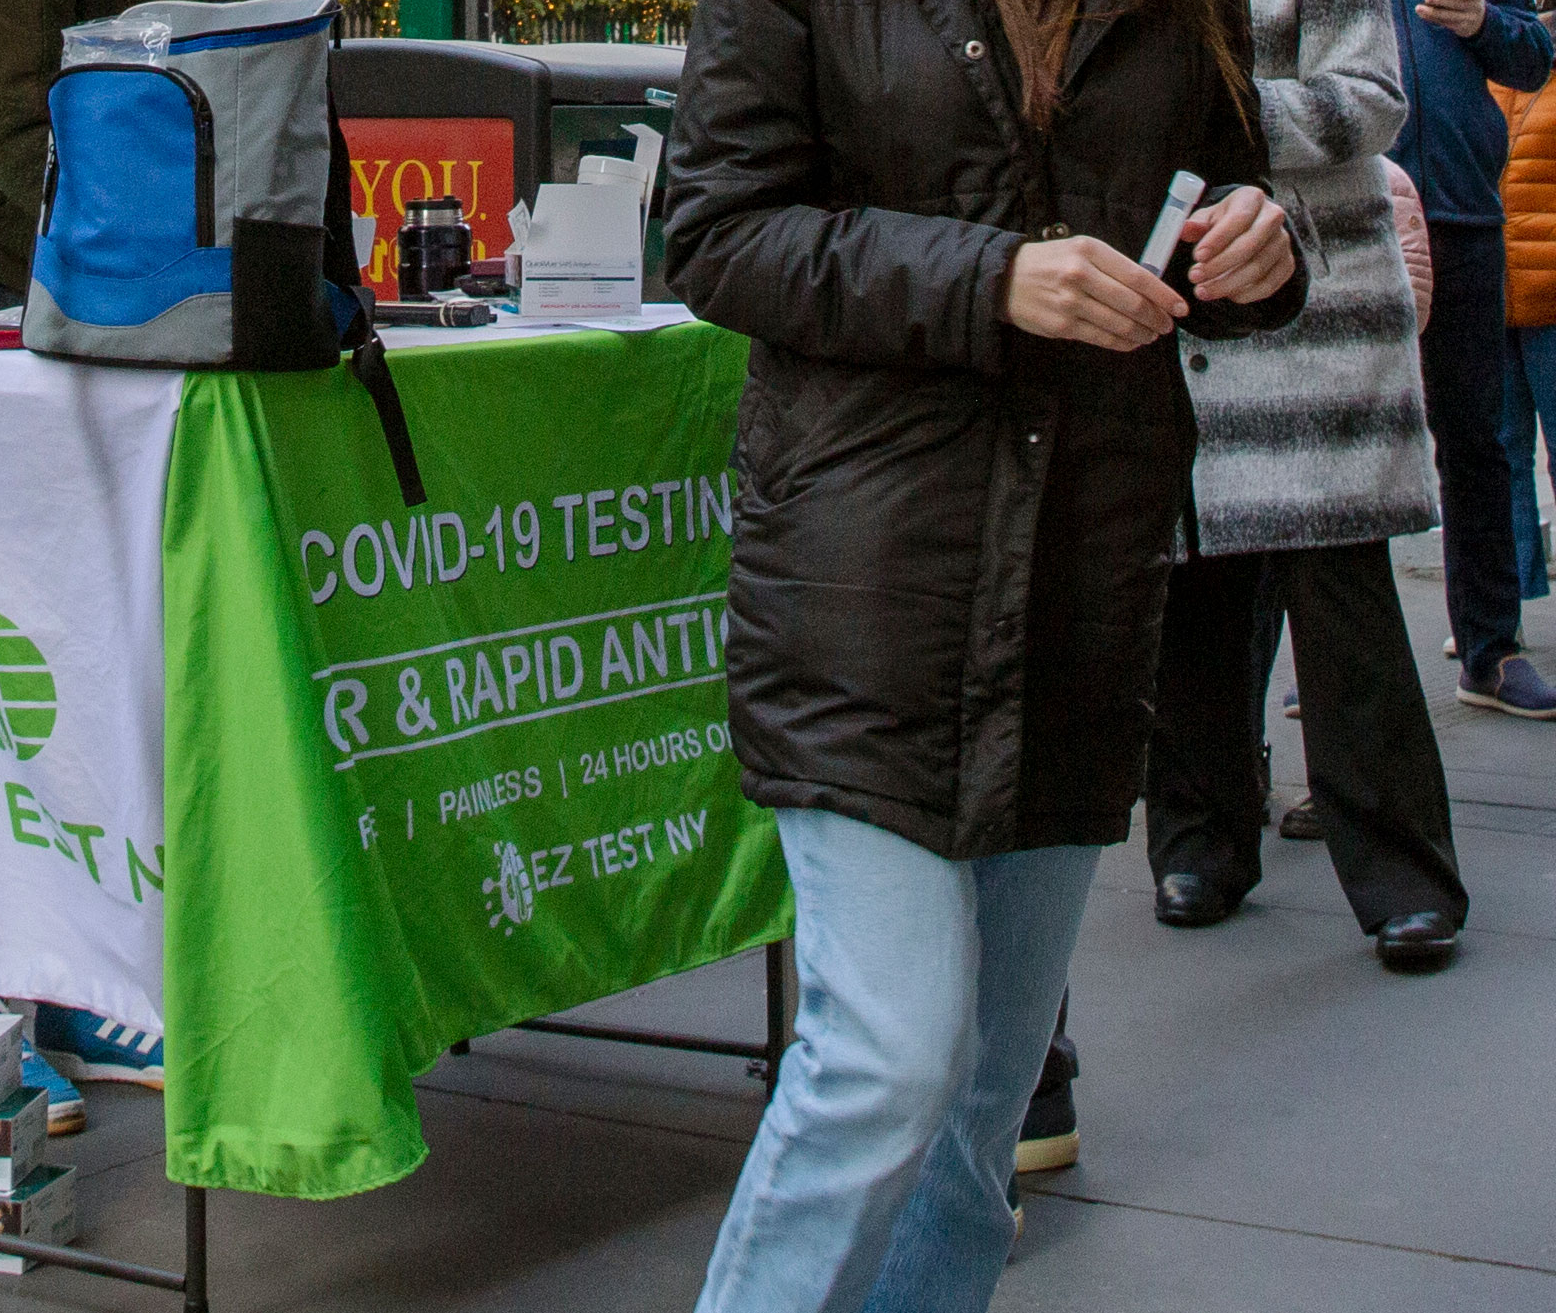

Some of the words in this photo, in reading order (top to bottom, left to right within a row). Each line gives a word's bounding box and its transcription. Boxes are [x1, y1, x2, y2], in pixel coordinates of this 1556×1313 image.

[300, 500, 541, 605] COVID-19
[552, 471, 733, 561] TESTIN
[396, 667, 437, 737] &
[445, 635, 584, 725] RAPID
[600, 607, 729, 688] ANTI
[439, 765, 544, 825] PAINLESS
[580, 752, 609, 785] 24
[614, 731, 703, 777] HOURS
[531, 844, 574, 892] EZ
[584, 823, 655, 879] TEST
[664, 808, 708, 857] NY
